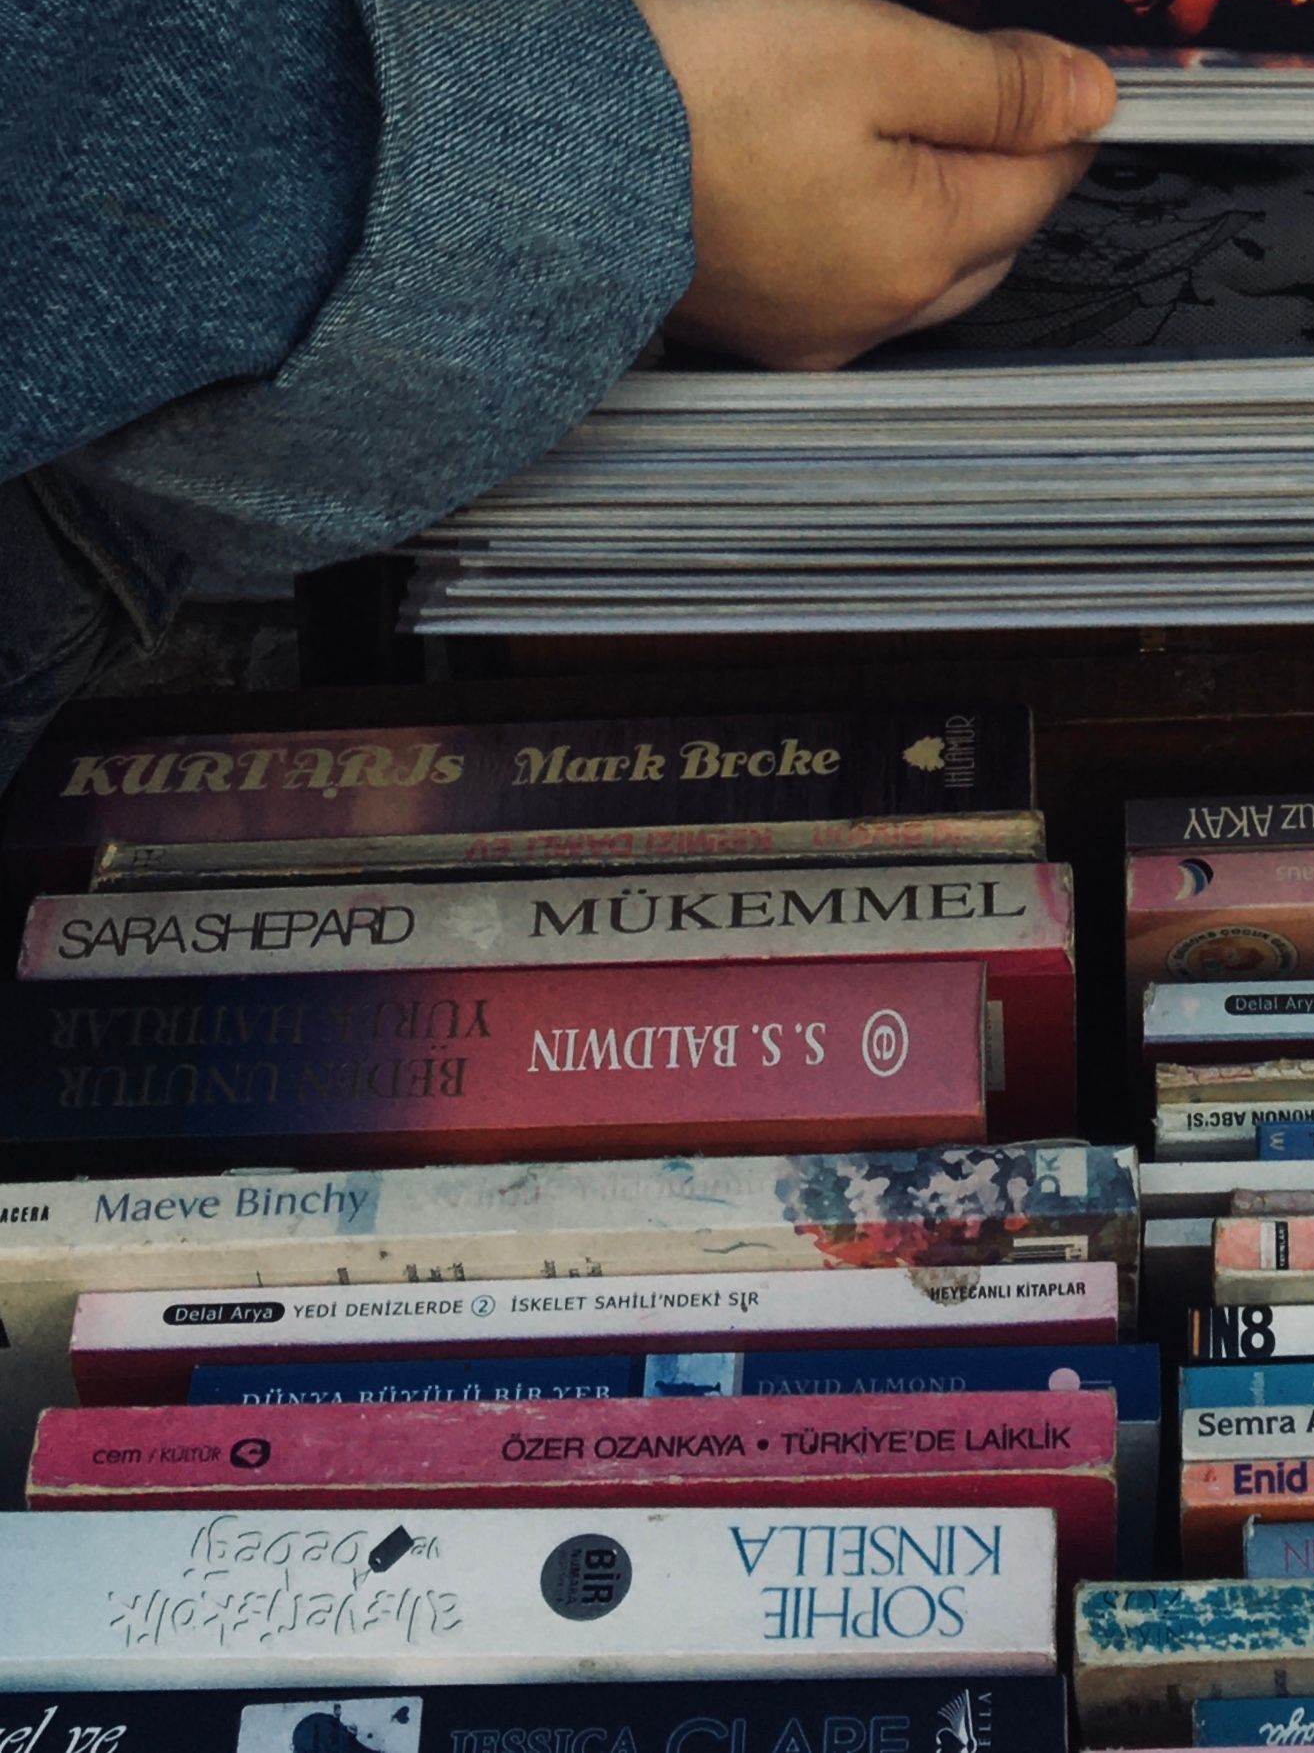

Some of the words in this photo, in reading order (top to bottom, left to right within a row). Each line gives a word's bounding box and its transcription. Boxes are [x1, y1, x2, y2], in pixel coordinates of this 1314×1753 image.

[512, 744, 666, 785] Mark
[944, 714, 975, 789] IHLAMUR
[1183, 804, 1273, 839] AKAY
[59, 915, 186, 959] SARA
[191, 905, 416, 951] SHEPARD
[530, 881, 1026, 937] MÜKEMMEL
[322, 999, 491, 1049] YÜREK
[1236, 995, 1280, 1012] Delal
[49, 1006, 306, 1049] HATIRLAR
[527, 1025, 741, 1072] BALDWIN
[751, 1022, 827, 1066] S.S.
[56, 1063, 279, 1107] UNUTUR
[294, 1058, 468, 1102] BEDEN
[94, 1192, 221, 1224] Maeve
[236, 1181, 372, 1221] Binchy
[175, 1306, 223, 1322] Delal
[230, 1305, 274, 1324] Arya
[294, 1300, 338, 1319] YEDİ
[345, 1297, 464, 1317] DENİZLERDE
[511, 1294, 587, 1313] İSKELET
[594, 1288, 720, 1310] SAHİLİ'NDEKİ
[727, 1291, 760, 1309] SIR
[930, 1285, 1011, 1303] HEYECANLI
[1016, 1279, 1086, 1299] KİTAPLAR
[242, 1388, 343, 1406] DÜNYA
[849, 1375, 966, 1395] ALMOND
[501, 1436, 584, 1462] ÖZER
[594, 1435, 746, 1460] OZANKAYA
[781, 1428, 956, 1455] TÜRKİYE'DE
[965, 1421, 1071, 1450] LAİKLİK
[1199, 1412, 1295, 1436] Semra
[92, 1447, 142, 1466] cem
[160, 1445, 222, 1464] KÜLTÜR
[1233, 1462, 1308, 1496] Enid
[729, 1525, 1002, 1577] KINSELLA
[582, 1548, 621, 1605] BİR
[761, 1585, 966, 1640] SOPHIE
